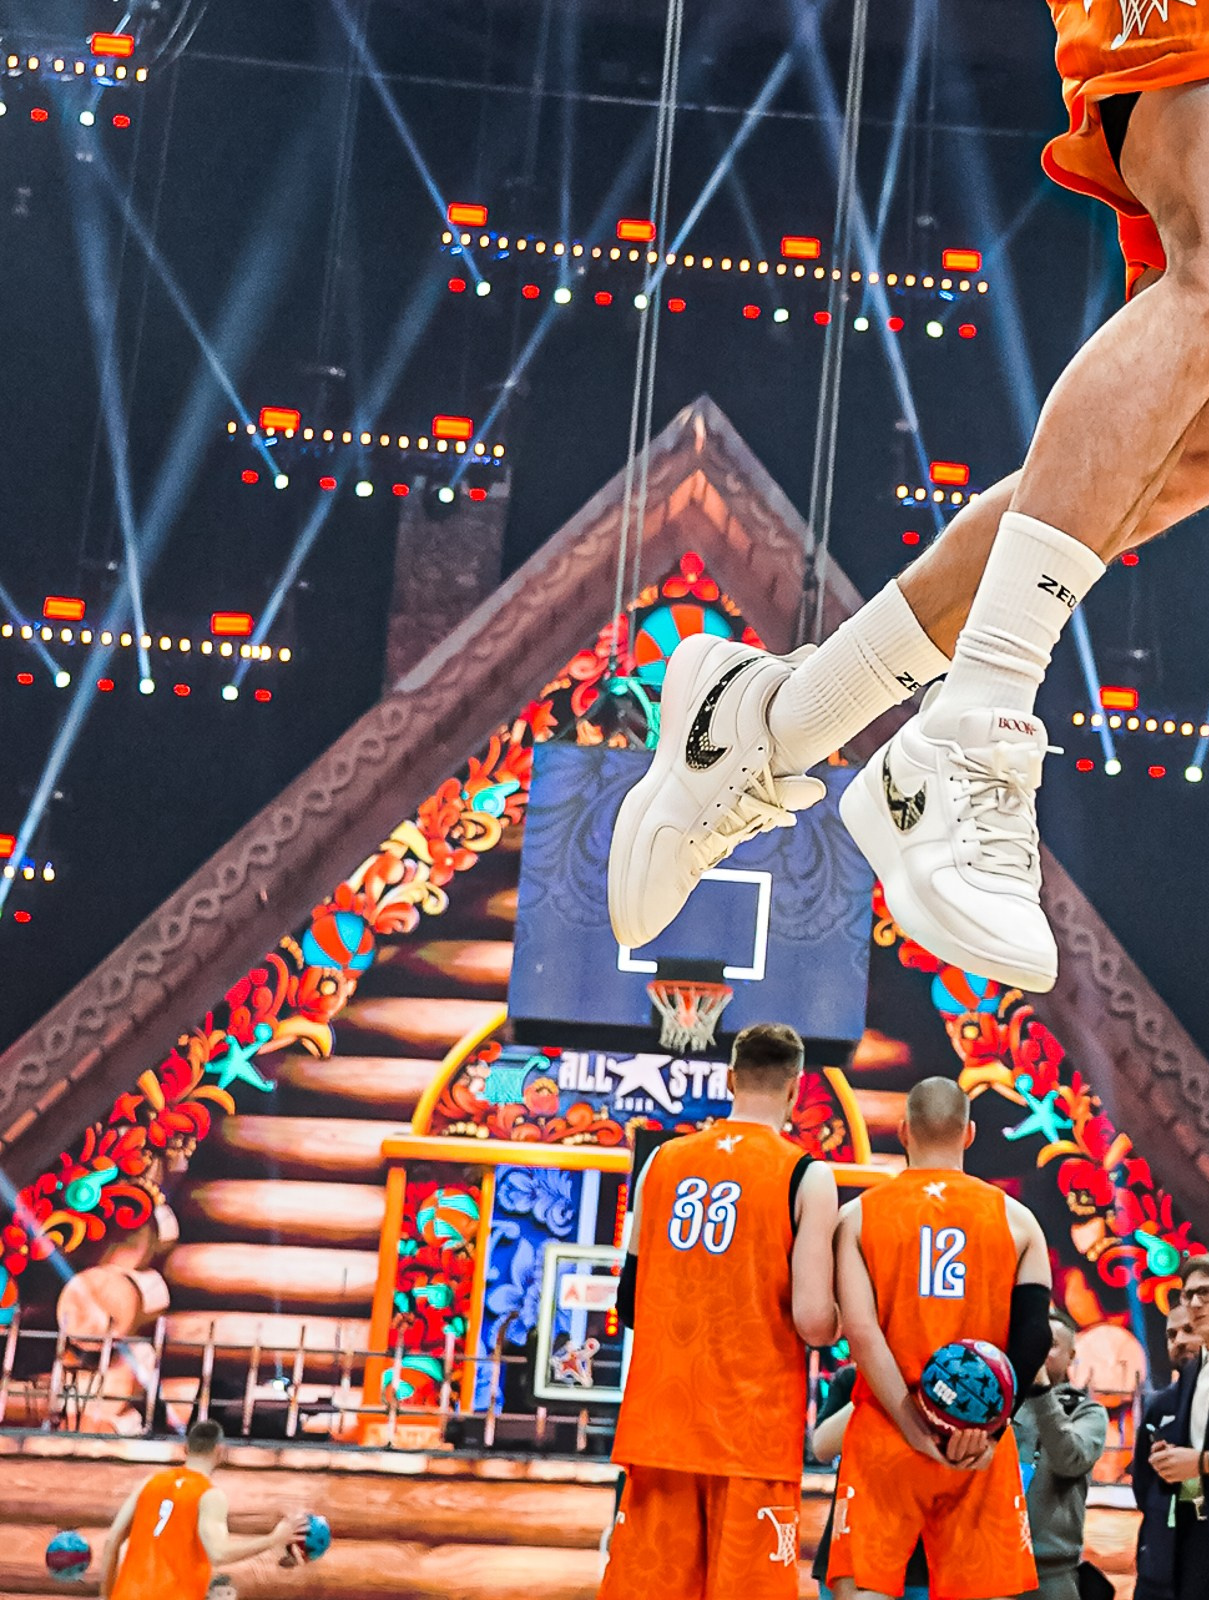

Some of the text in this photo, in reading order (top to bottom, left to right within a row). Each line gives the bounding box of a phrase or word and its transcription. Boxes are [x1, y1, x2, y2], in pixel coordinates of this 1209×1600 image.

[559, 1051, 735, 1101] ALL STA
[668, 1175, 742, 1255] 33
[919, 1224, 967, 1298] 12
